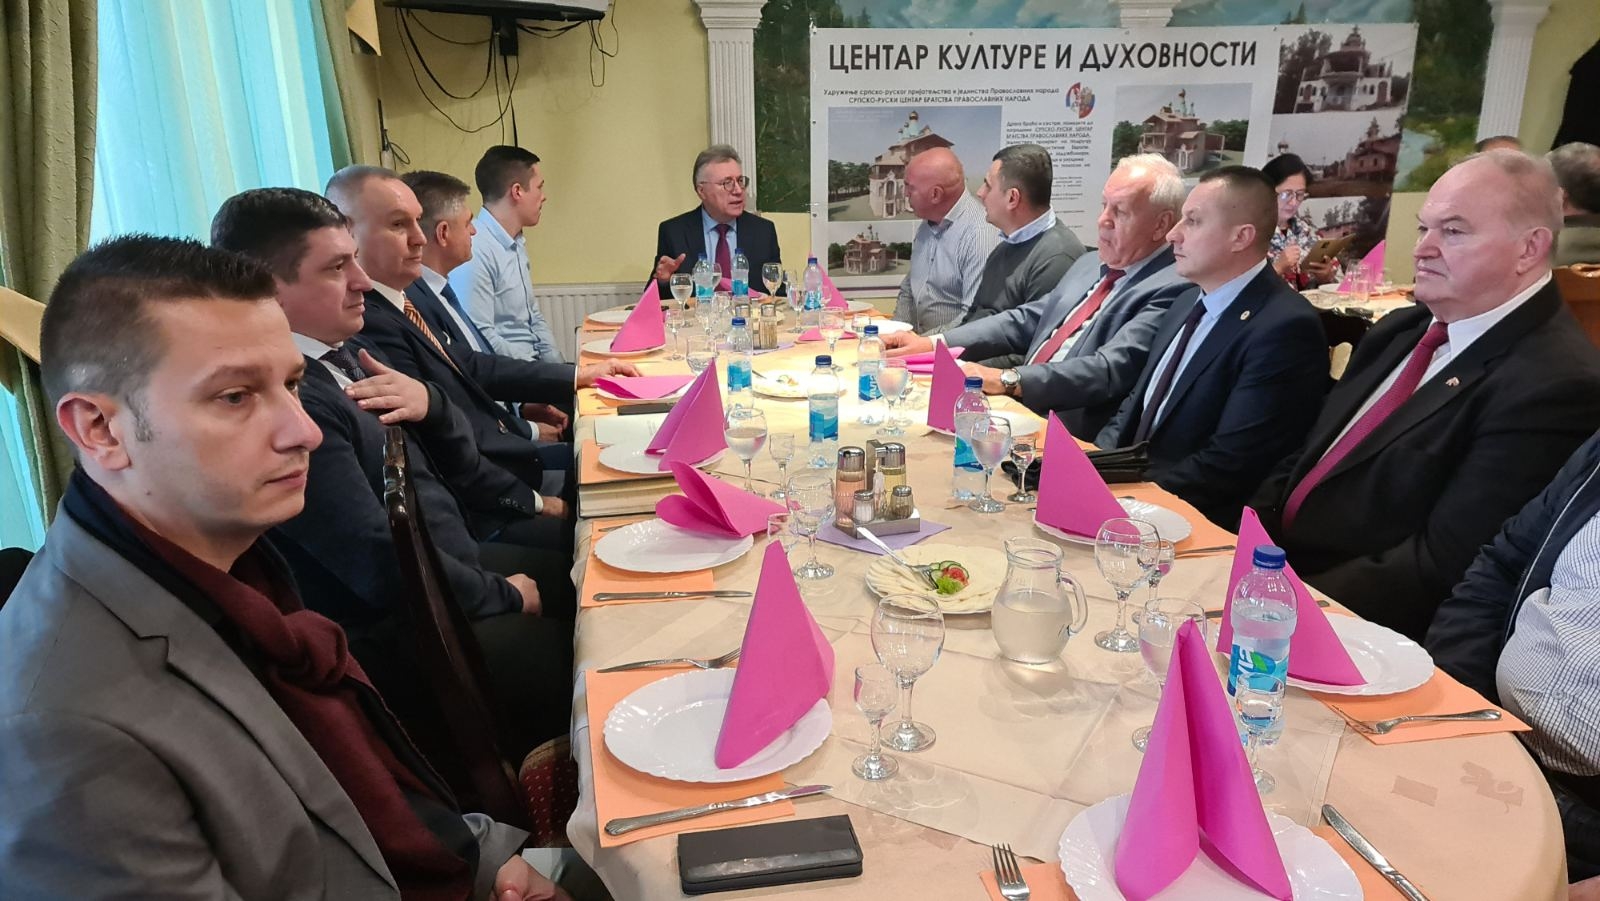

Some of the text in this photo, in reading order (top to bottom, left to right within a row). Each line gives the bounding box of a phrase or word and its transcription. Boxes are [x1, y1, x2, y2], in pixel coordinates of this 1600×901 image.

[829, 41, 1257, 73] ЦЕНТАР КУЛТУРЕ И ДУХОВНОСТИ
[1035, 87, 1060, 95] народа
